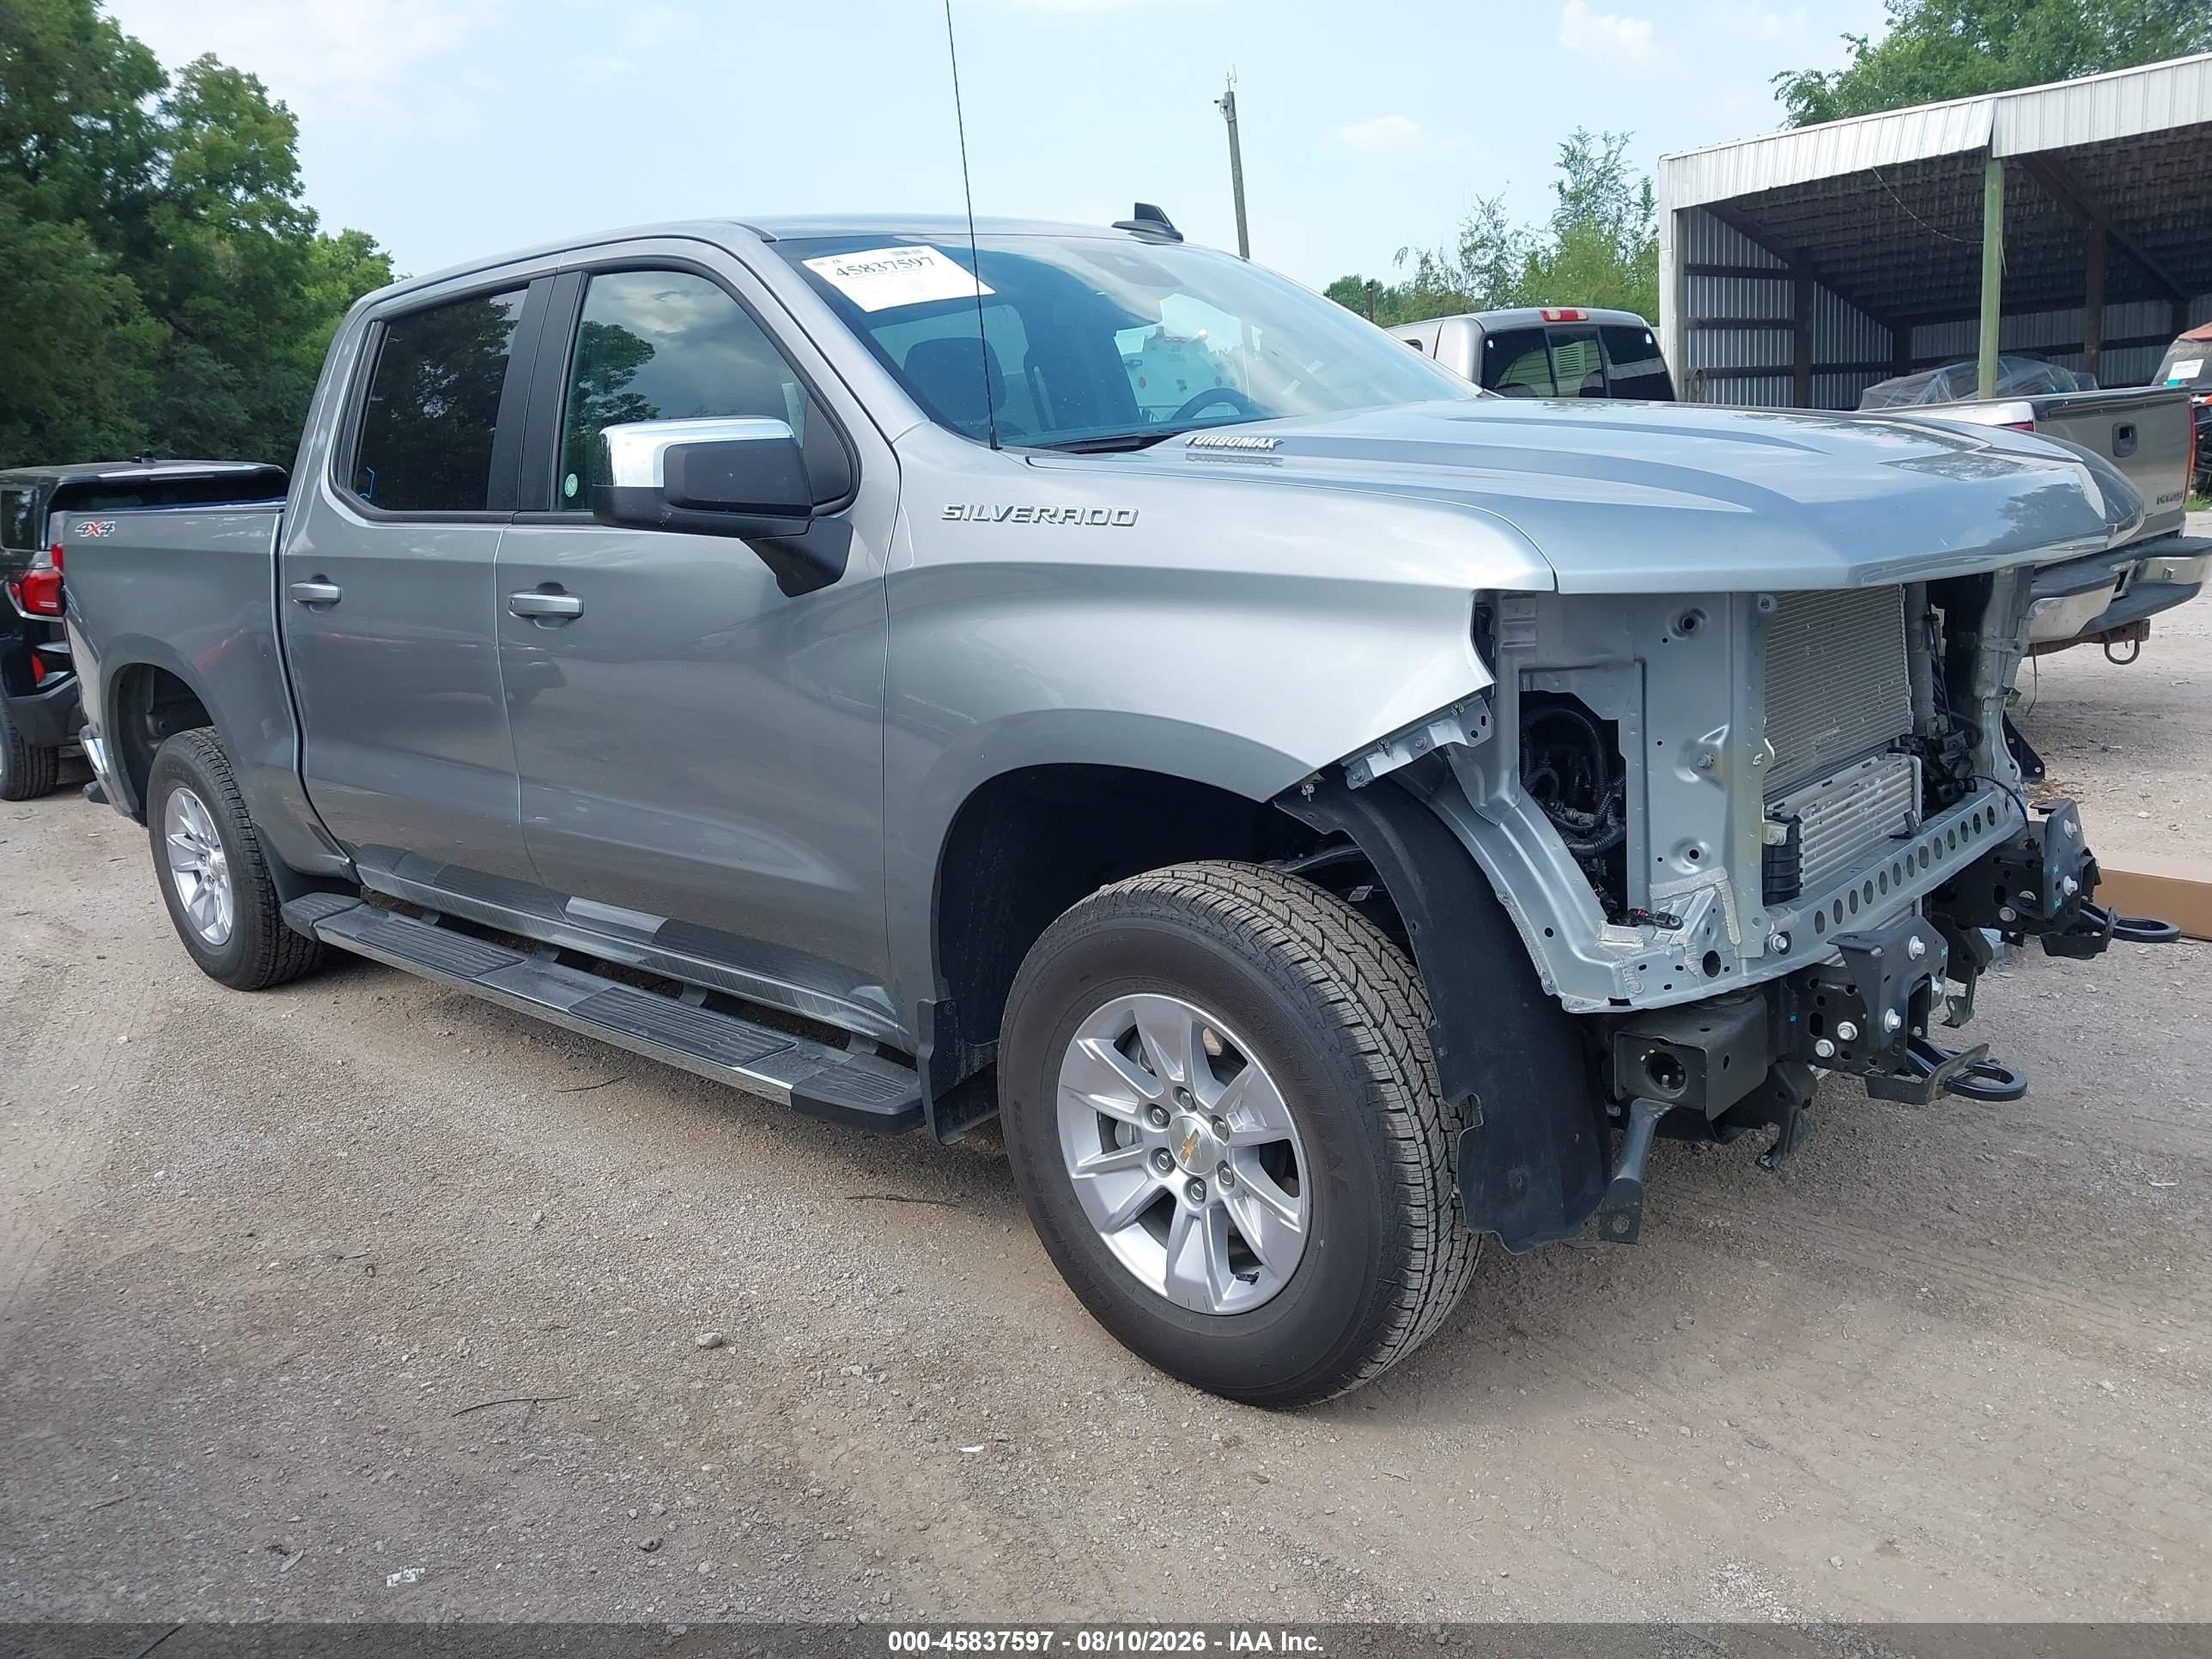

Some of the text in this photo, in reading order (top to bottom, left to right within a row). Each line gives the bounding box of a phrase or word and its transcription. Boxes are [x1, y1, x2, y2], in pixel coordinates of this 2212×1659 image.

[836, 256, 935, 277] 45837597
[1185, 434, 1285, 451] TURBOMAX
[941, 504, 1139, 527] SILVERADO
